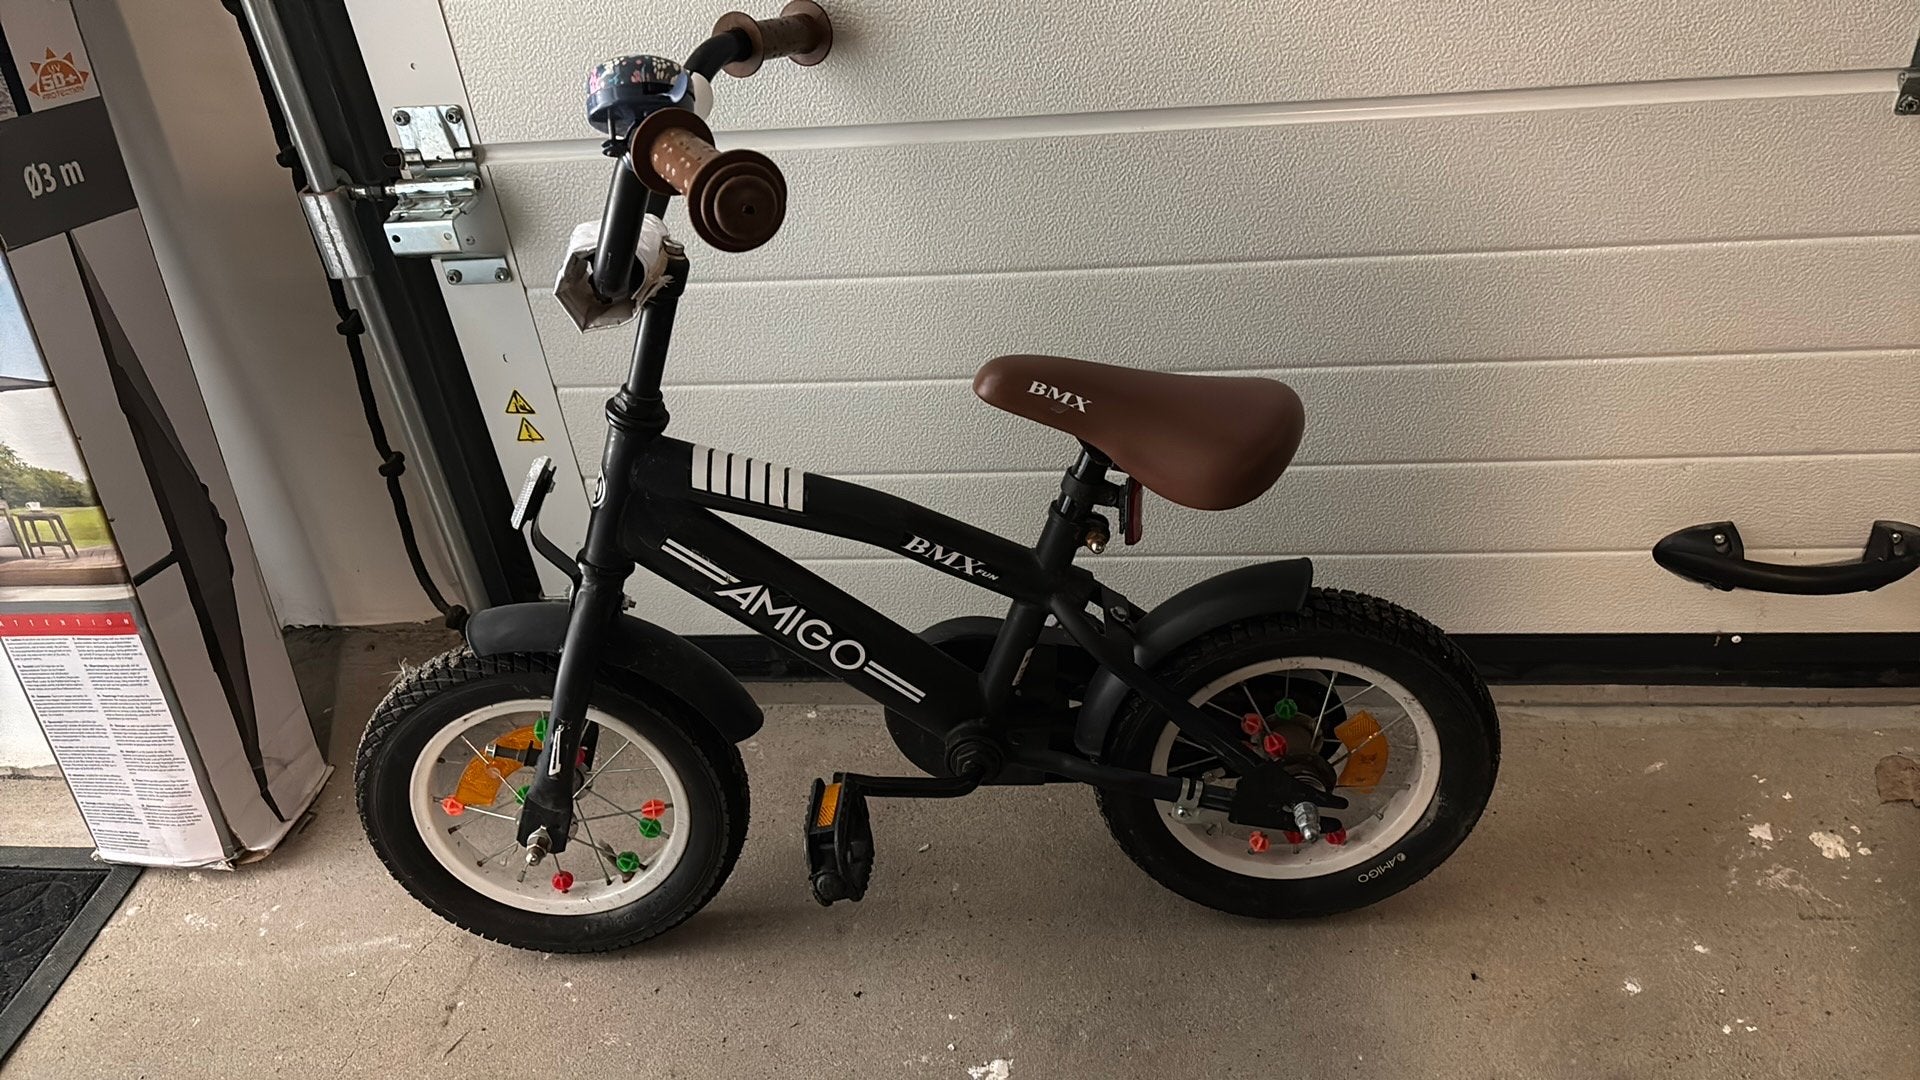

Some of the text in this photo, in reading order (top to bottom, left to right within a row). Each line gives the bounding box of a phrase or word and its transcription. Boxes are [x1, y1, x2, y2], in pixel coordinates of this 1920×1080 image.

[41, 72, 78, 90] 50+
[59, 160, 85, 187] m
[1027, 381, 1093, 414] BMX
[901, 535, 1000, 581] BMX FUN
[714, 584, 866, 670] AMIGO
[1357, 857, 1398, 882] AMIGO
